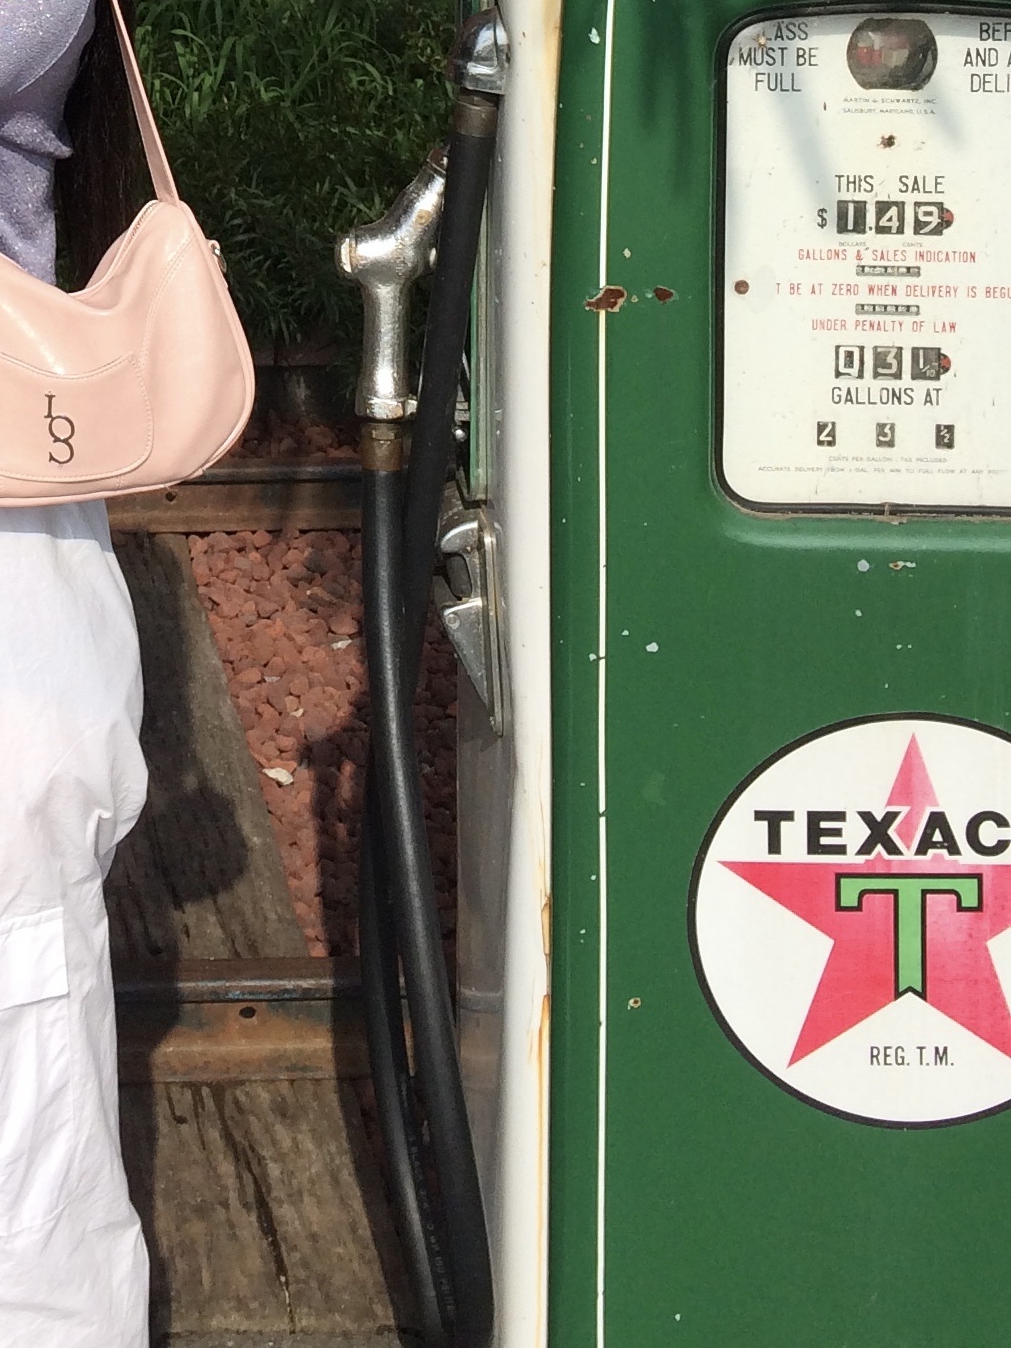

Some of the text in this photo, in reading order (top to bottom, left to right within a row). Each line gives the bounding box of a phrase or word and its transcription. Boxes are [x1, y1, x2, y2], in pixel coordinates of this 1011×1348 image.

[739, 47, 788, 67] MUST
[796, 47, 819, 67] BE
[964, 47, 999, 67] AND
[755, 73, 801, 92] FULL
[970, 73, 1011, 93] DELI
[835, 175, 945, 194] THIS SALE
[798, 249, 976, 263] GALLONS & SALES INDICATION
[789, 283, 802, 295] BE
[810, 283, 823, 295] AT
[831, 283, 859, 296] ZERO
[867, 284, 898, 297] WHEN
[905, 284, 959, 298] DELIVERY
[966, 285, 977, 298] IS
[812, 319, 957, 334] UNDER PENALTY OF LAW
[832, 386, 943, 406] GALLONS AT
[835, 873, 984, 1001] T
[869, 1045, 911, 1067] REG.
